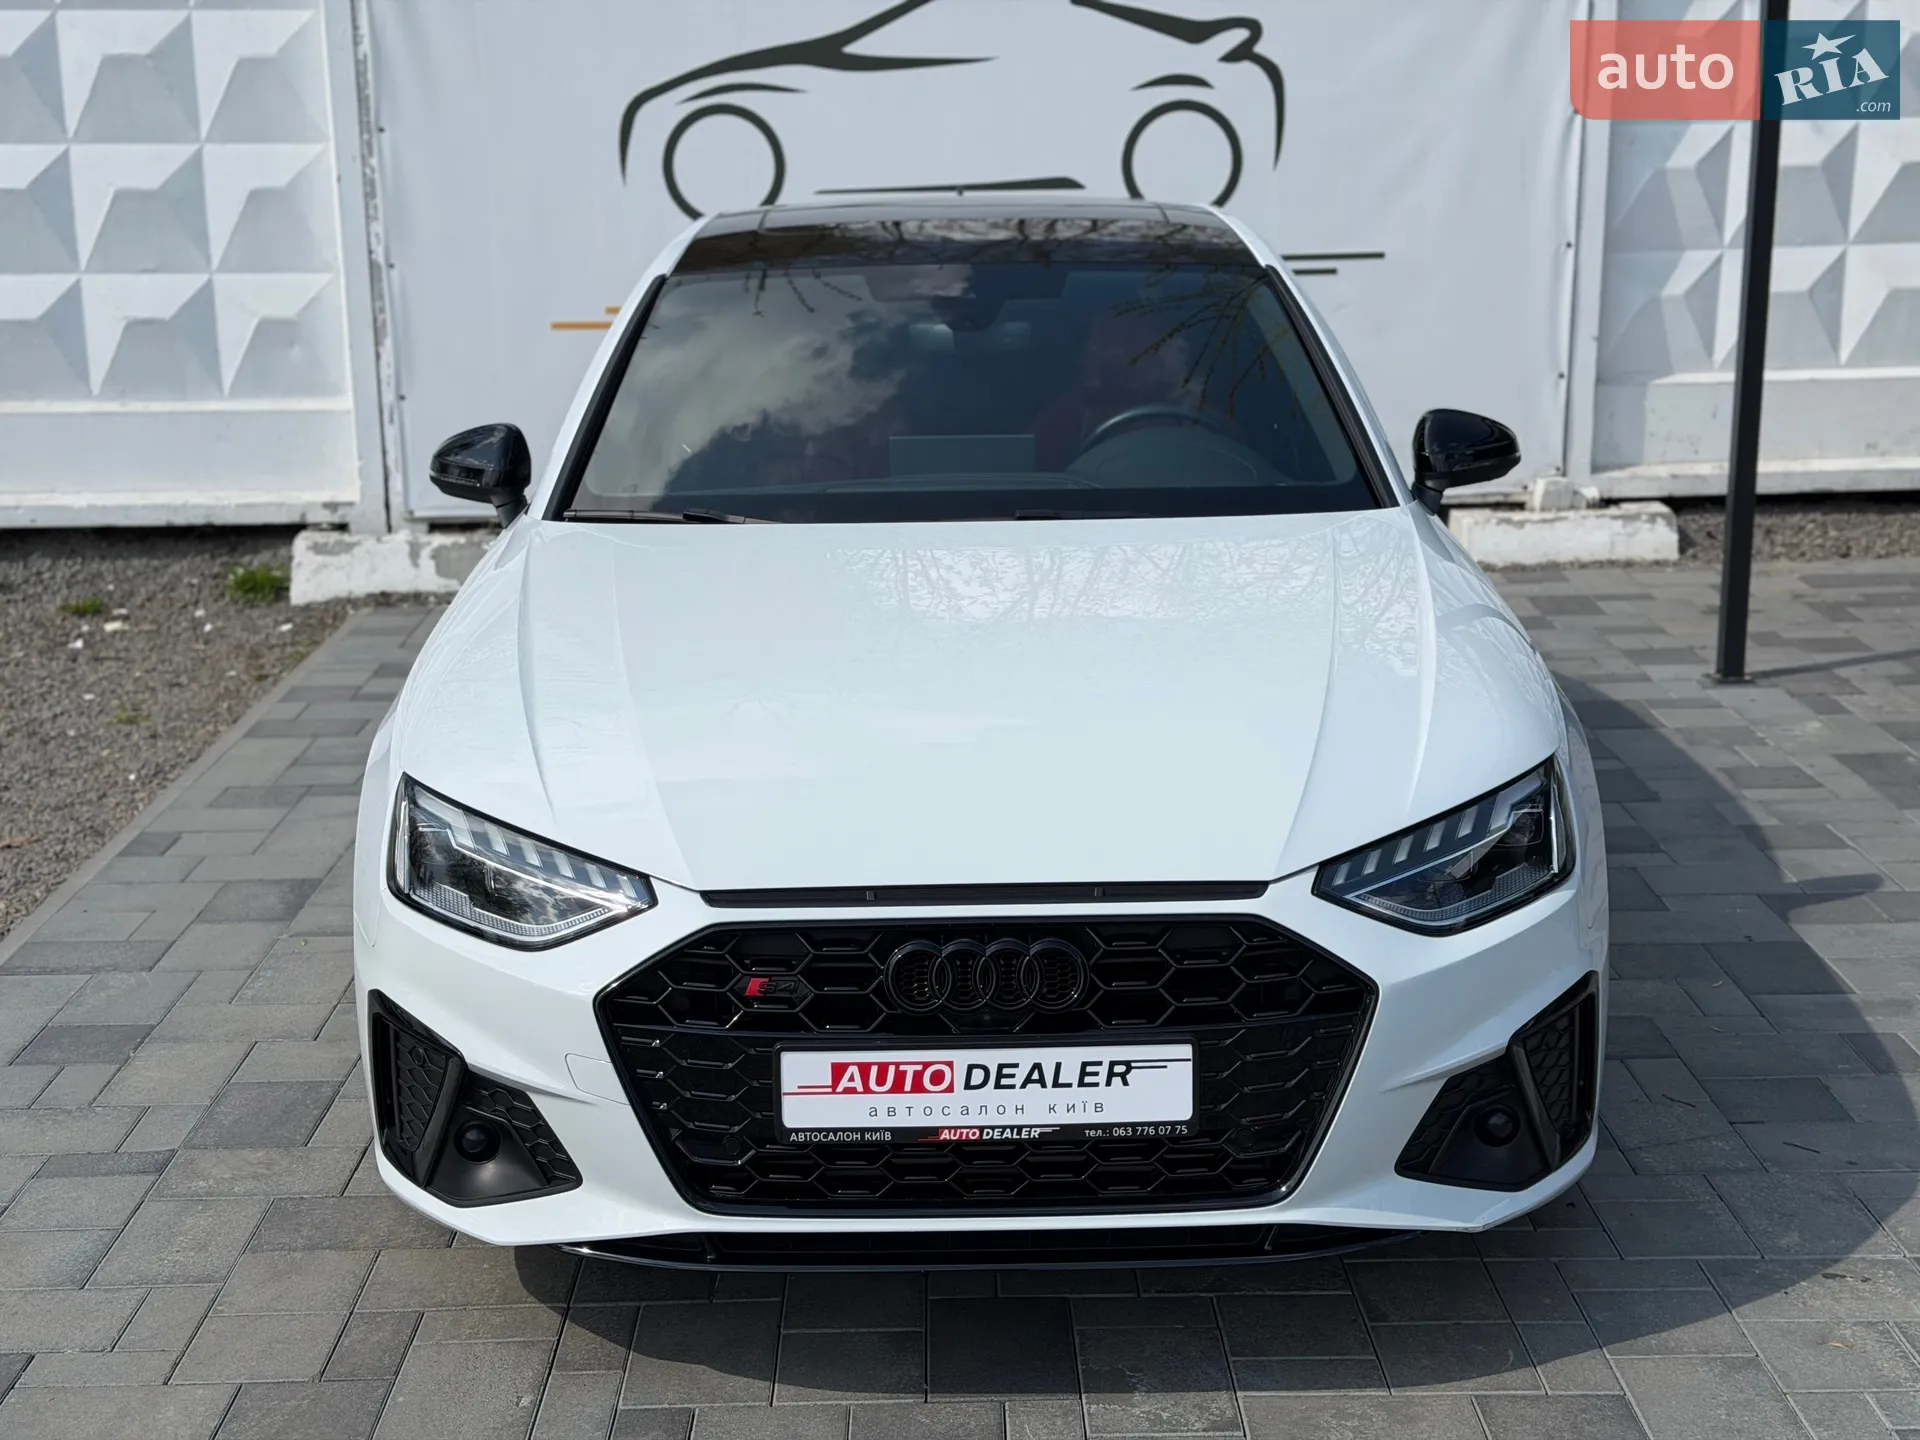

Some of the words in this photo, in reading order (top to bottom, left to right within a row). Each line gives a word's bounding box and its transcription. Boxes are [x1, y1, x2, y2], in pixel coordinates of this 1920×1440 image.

[835, 1063, 953, 1093] AUTO
[963, 1060, 1131, 1091] DEALER
[868, 1104, 1025, 1118] автосалон
[789, 1131, 861, 1142] АВТОСАЛОН
[864, 1129, 892, 1141] КИЇВ
[939, 1128, 980, 1140] AUTO
[982, 1127, 1040, 1140] DEALER
[1084, 1129, 1110, 1137] тел.:
[1112, 1126, 1133, 1136] 063
[1135, 1126, 1155, 1136] 776
[1158, 1125, 1171, 1135] 07
[1175, 1125, 1188, 1135] 75
